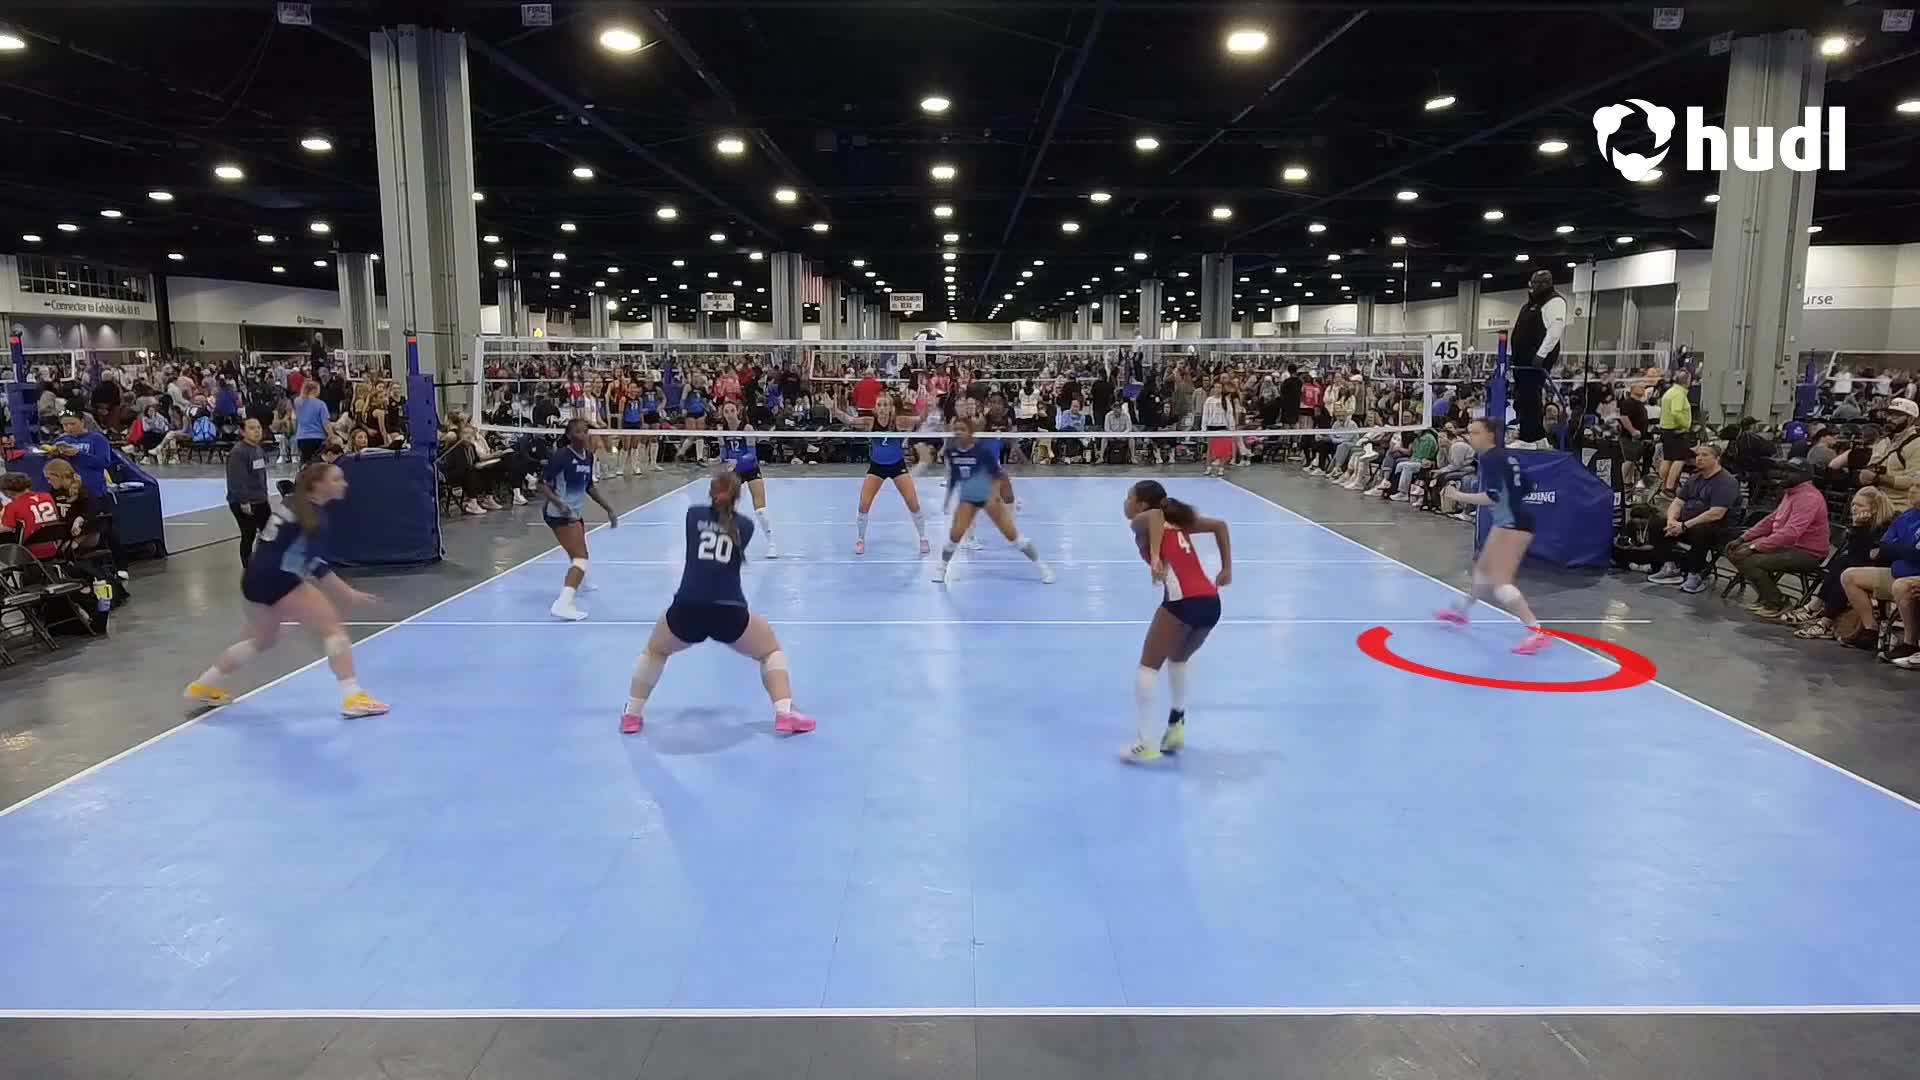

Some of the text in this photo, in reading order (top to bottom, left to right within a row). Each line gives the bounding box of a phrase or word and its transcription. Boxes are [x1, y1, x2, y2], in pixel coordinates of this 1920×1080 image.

[1435, 341, 1458, 359] 45
[30, 501, 58, 523] 12
[697, 530, 733, 564] 20
[1177, 531, 1191, 554] 4
